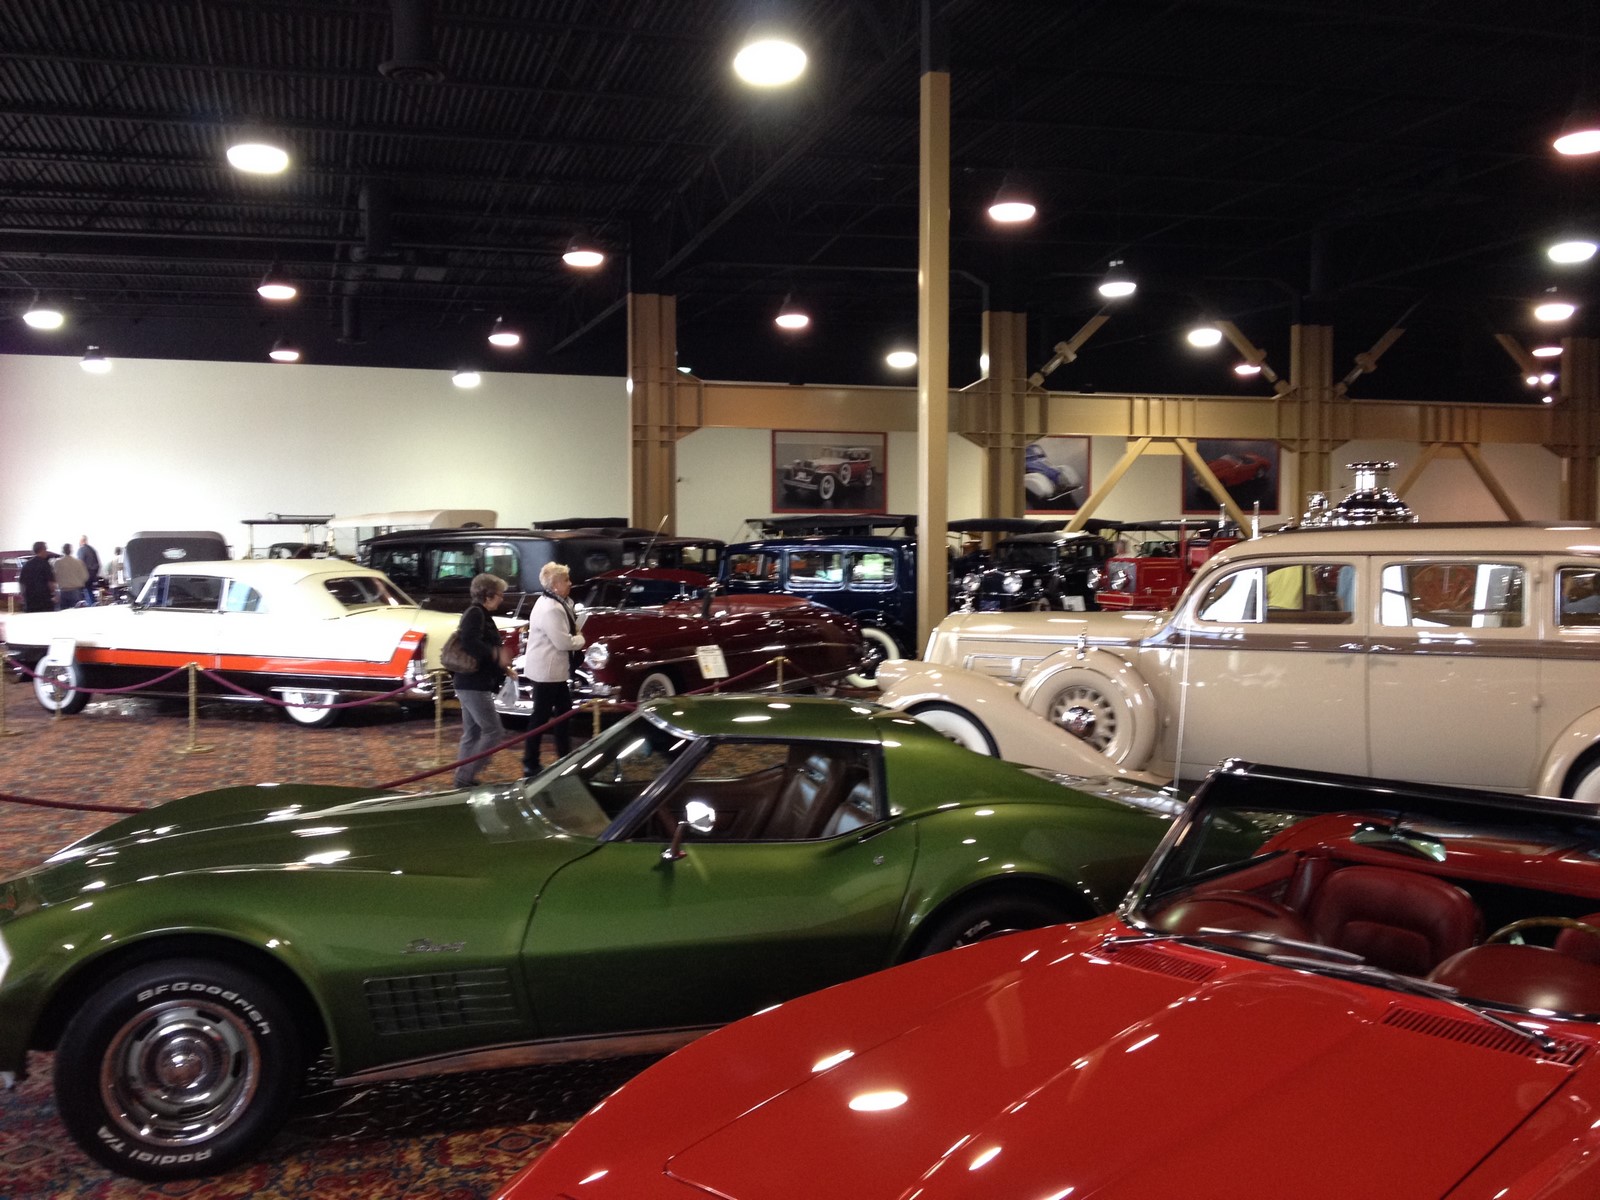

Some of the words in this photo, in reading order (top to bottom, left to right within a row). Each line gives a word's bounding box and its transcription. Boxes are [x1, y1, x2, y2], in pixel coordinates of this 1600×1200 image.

[136, 982, 271, 1035] BFGoodrich
[97, 1125, 126, 1153] T/A
[129, 1148, 213, 1165] Radial
